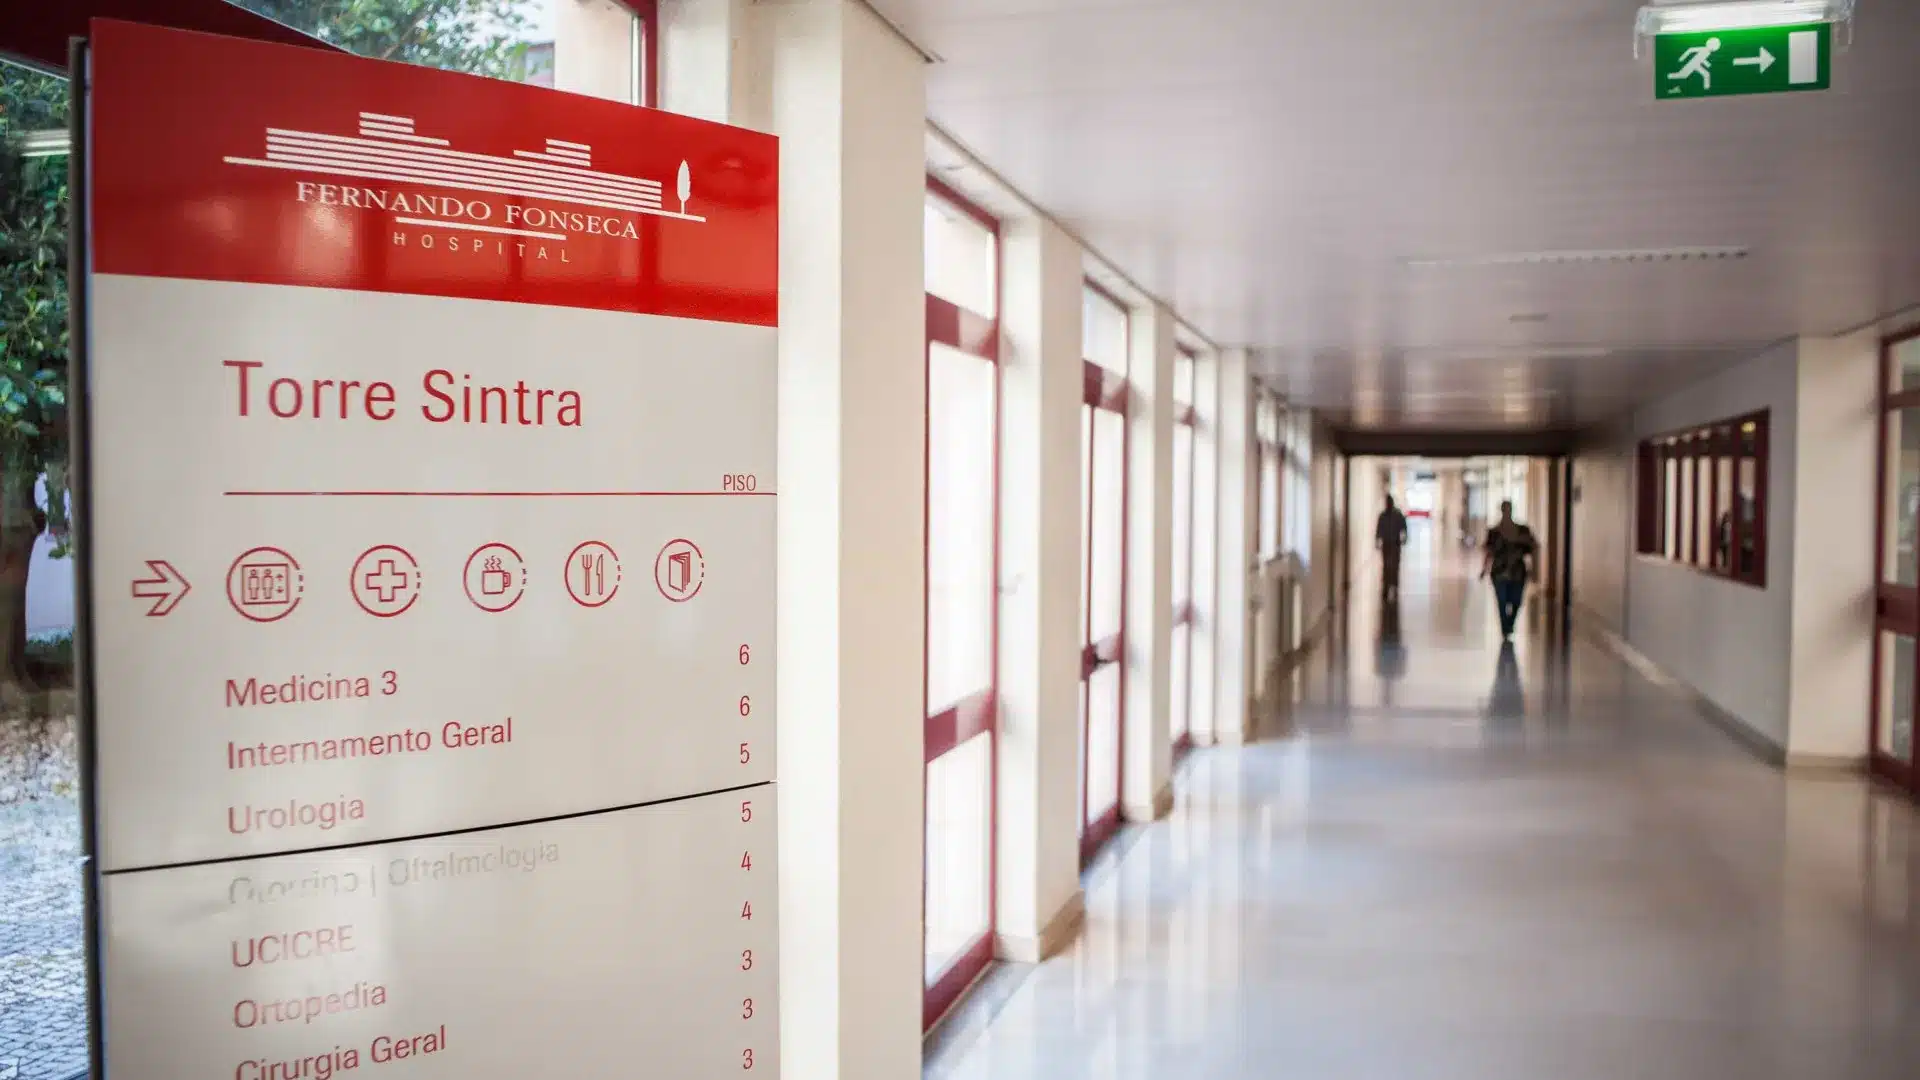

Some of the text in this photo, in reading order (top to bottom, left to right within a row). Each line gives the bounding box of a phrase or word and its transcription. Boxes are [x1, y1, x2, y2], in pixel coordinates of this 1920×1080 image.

[296, 181, 640, 240] FERNANDO FONSECA
[393, 232, 571, 263] HOSPITAL
[223, 359, 582, 426] Torre Sintra
[722, 474, 757, 492] PISO
[738, 644, 750, 665] 6
[225, 670, 398, 707] Medicina 3
[739, 695, 750, 716] 6
[227, 717, 512, 770] Internamento Geral
[740, 743, 750, 764] 5
[228, 794, 365, 834] Urologia
[741, 801, 752, 822] 5
[741, 850, 752, 871] 4
[741, 900, 752, 921] 4
[232, 925, 356, 968] UCICRE
[742, 949, 753, 971] 3
[233, 981, 387, 1029] Ortopedia
[743, 998, 753, 1020] 3
[235, 1024, 447, 1080] Cirurgia Geral
[743, 1048, 753, 1070] 3
